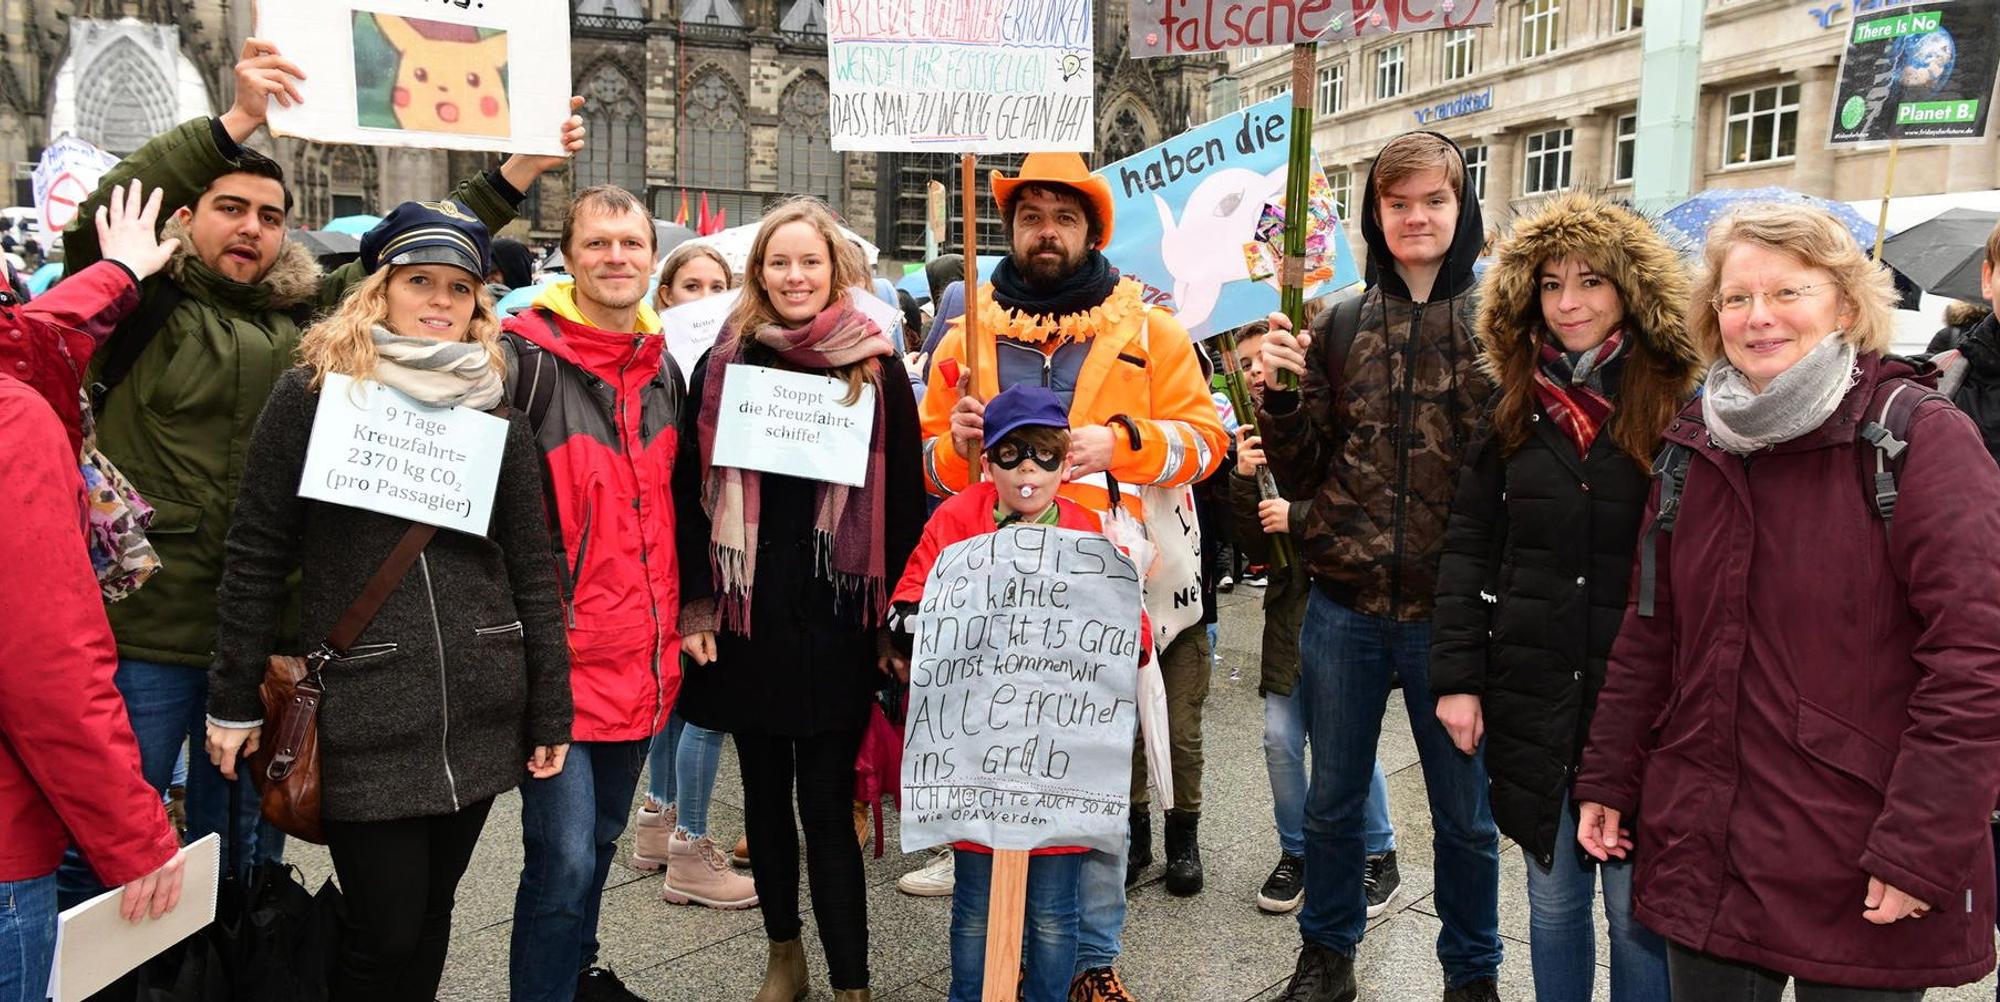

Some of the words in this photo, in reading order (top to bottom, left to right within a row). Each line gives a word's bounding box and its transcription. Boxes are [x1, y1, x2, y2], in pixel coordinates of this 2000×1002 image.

[1002, 0, 1089, 47] ERTRUNKEN
[1160, 0, 1331, 54] falsche
[1857, 23, 1892, 40] There
[1896, 19, 1908, 34] Is
[1912, 16, 1937, 32] No
[833, 45, 908, 87] WERDET
[913, 46, 941, 88] IHR
[946, 49, 1049, 94] FESTSTELLEN
[831, 93, 868, 138] DASS
[874, 92, 909, 136] MAN
[910, 92, 936, 134] ZU
[937, 92, 991, 136] WENIG
[996, 92, 1056, 141] GETAN
[1051, 93, 1092, 142] HAT
[1435, 85, 1494, 119] randstad
[1900, 106, 1952, 121] Planet
[1956, 104, 1975, 119] B.
[1120, 132, 1225, 199] haben
[1235, 113, 1286, 154] die
[773, 385, 824, 405] Stoppt
[386, 406, 397, 421] 9
[403, 410, 447, 437] Tage
[739, 400, 763, 415] die
[767, 404, 856, 429] Kreuzfahrt-
[353, 423, 467, 463] Kreuzfahrt=
[765, 425, 821, 444] schiffe!
[347, 447, 398, 472] 2370
[403, 459, 425, 483] kg
[326, 468, 369, 492] (pro
[376, 478, 472, 518] Passagier)
[923, 576, 968, 613] die
[920, 614, 1032, 655] knackt
[1042, 617, 1073, 650] 1,5
[1079, 619, 1137, 658] Grad
[1025, 690, 1134, 728] früher
[913, 748, 955, 783] ins
[982, 734, 1070, 780] Grab
[910, 786, 938, 811] ICH
[1036, 794, 1076, 810] AUCH
[1102, 802, 1126, 816] ALT
[951, 810, 979, 821] OPA
